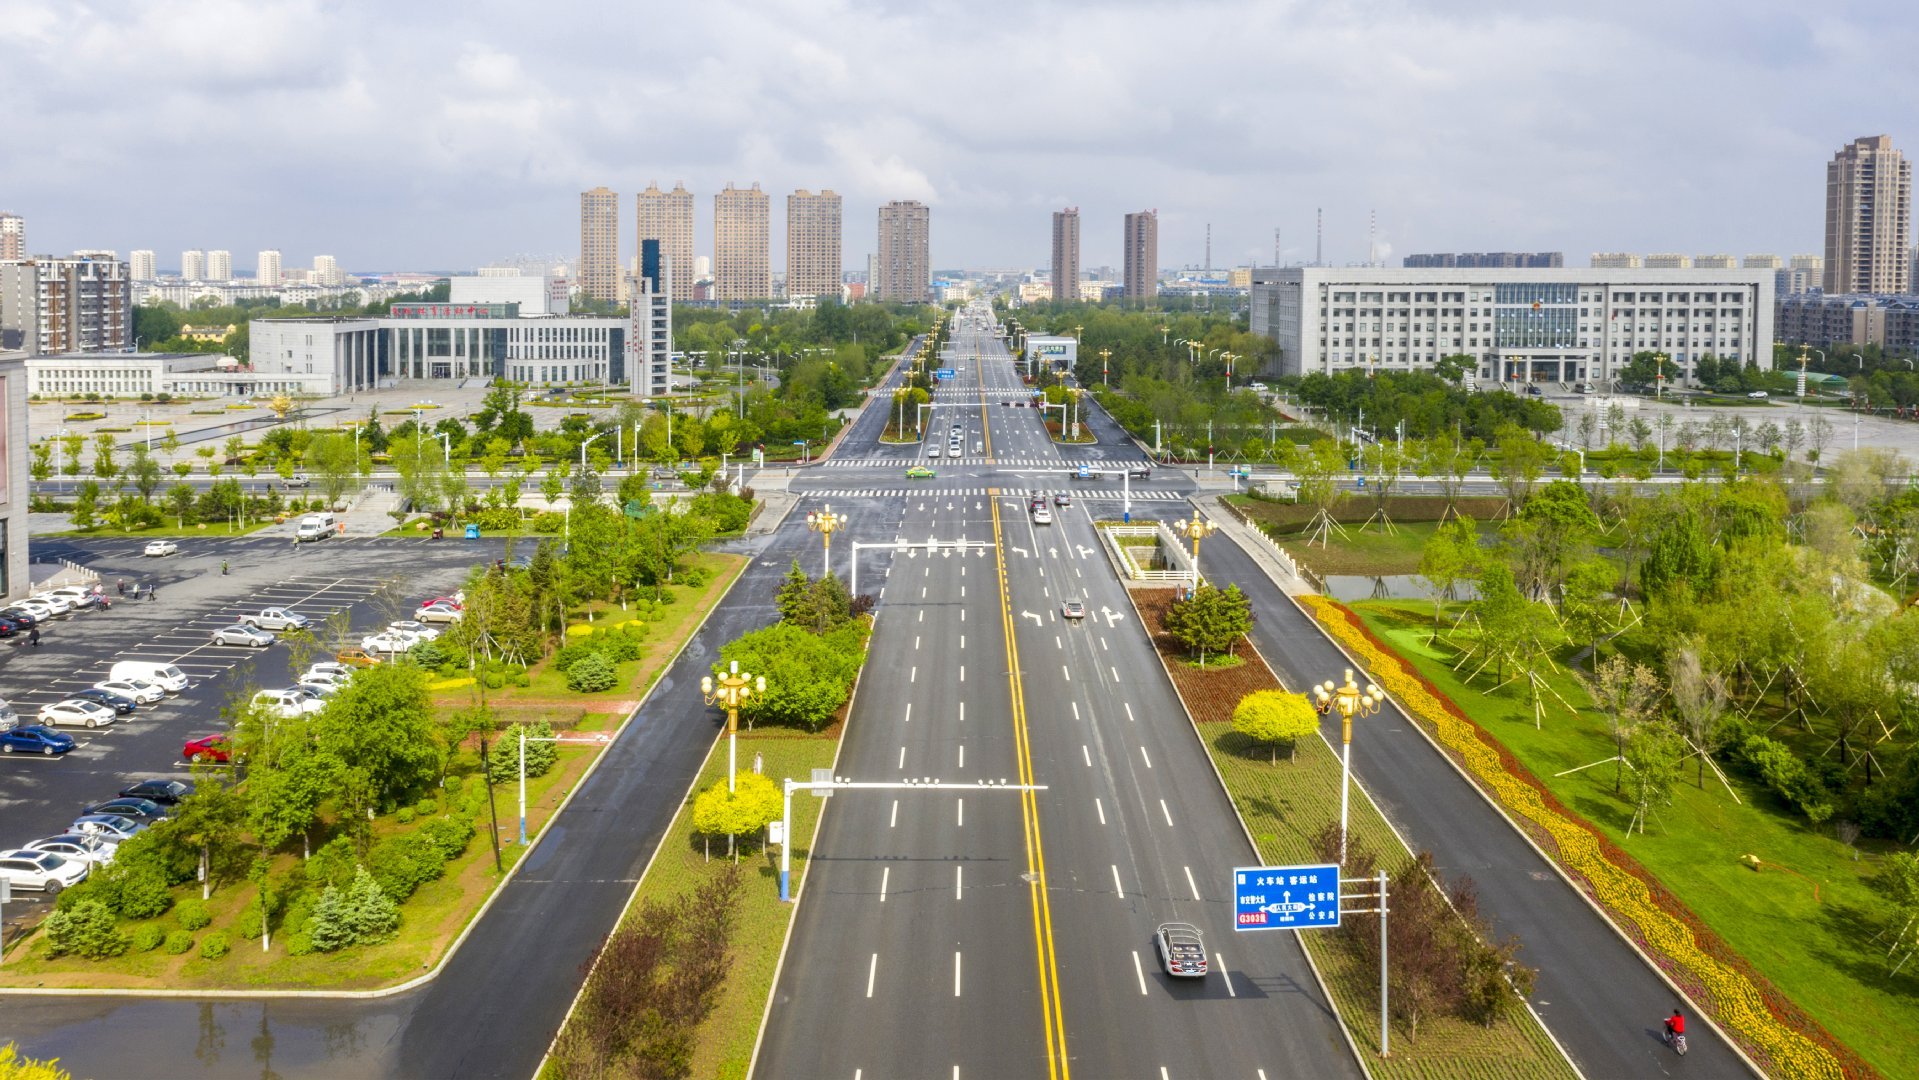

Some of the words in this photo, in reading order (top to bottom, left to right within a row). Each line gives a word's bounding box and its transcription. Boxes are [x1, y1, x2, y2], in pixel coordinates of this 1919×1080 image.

[1257, 877, 1284, 886] 火车站
[1290, 875, 1318, 885] 客运站
[1308, 892, 1334, 902] 检察院
[1239, 913, 1266, 923] G303线
[1308, 910, 1334, 920] 公安局
